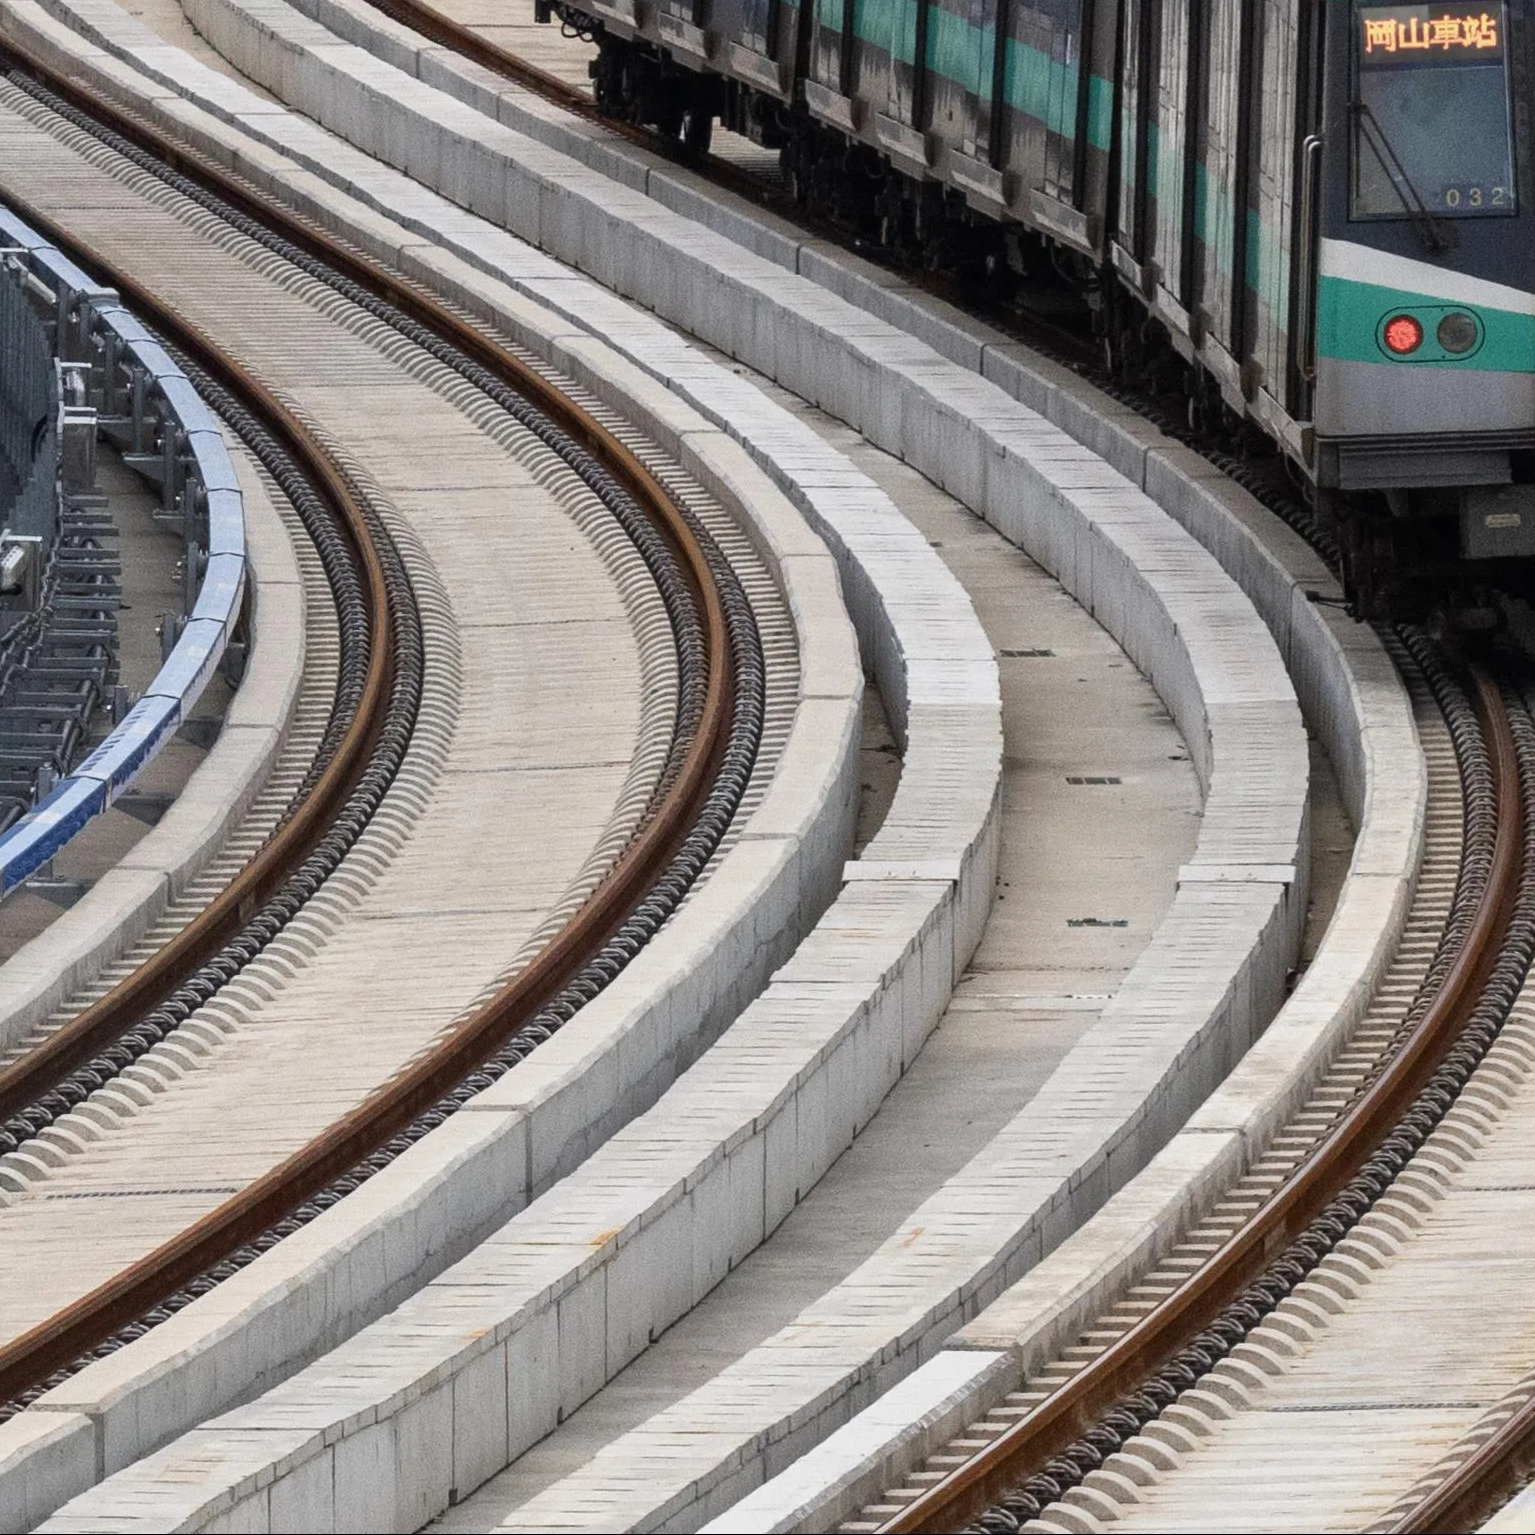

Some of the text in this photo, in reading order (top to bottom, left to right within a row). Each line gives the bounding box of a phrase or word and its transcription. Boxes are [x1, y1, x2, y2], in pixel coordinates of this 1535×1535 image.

[1365, 14, 1497, 53] 岡山車站
[1445, 187, 1506, 207] 032
